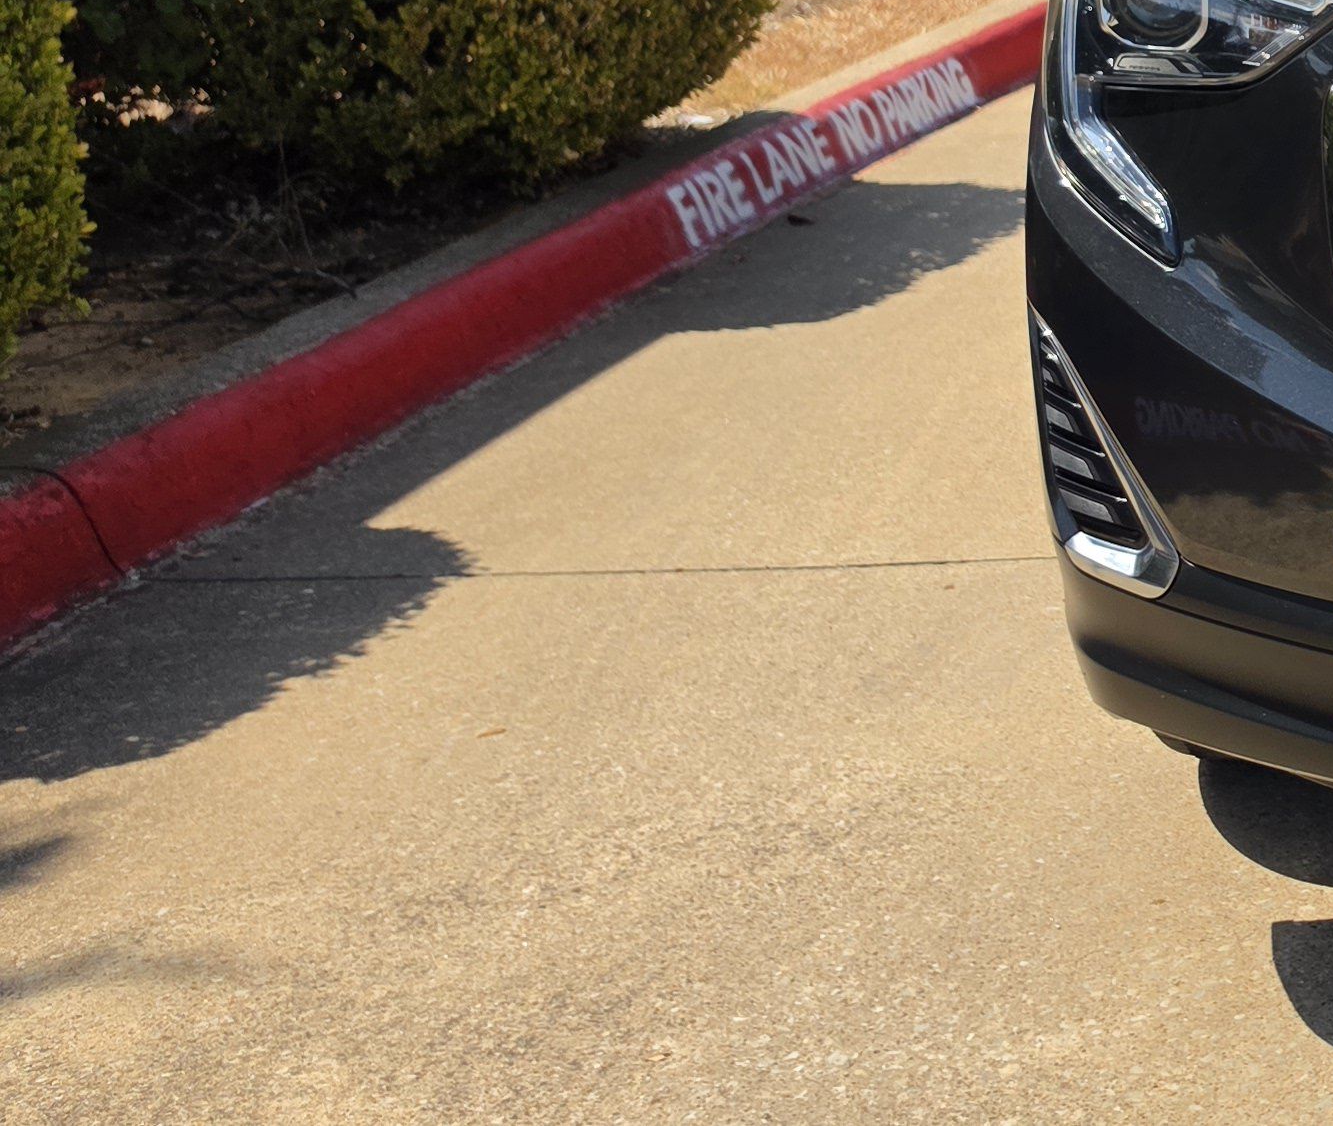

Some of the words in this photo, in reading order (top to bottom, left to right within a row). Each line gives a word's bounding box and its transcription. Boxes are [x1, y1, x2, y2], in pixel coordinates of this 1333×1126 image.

[667, 162, 757, 249] FIRE
[741, 119, 835, 204] LANE
[827, 98, 883, 160] NO
[872, 58, 977, 140] PARKING
